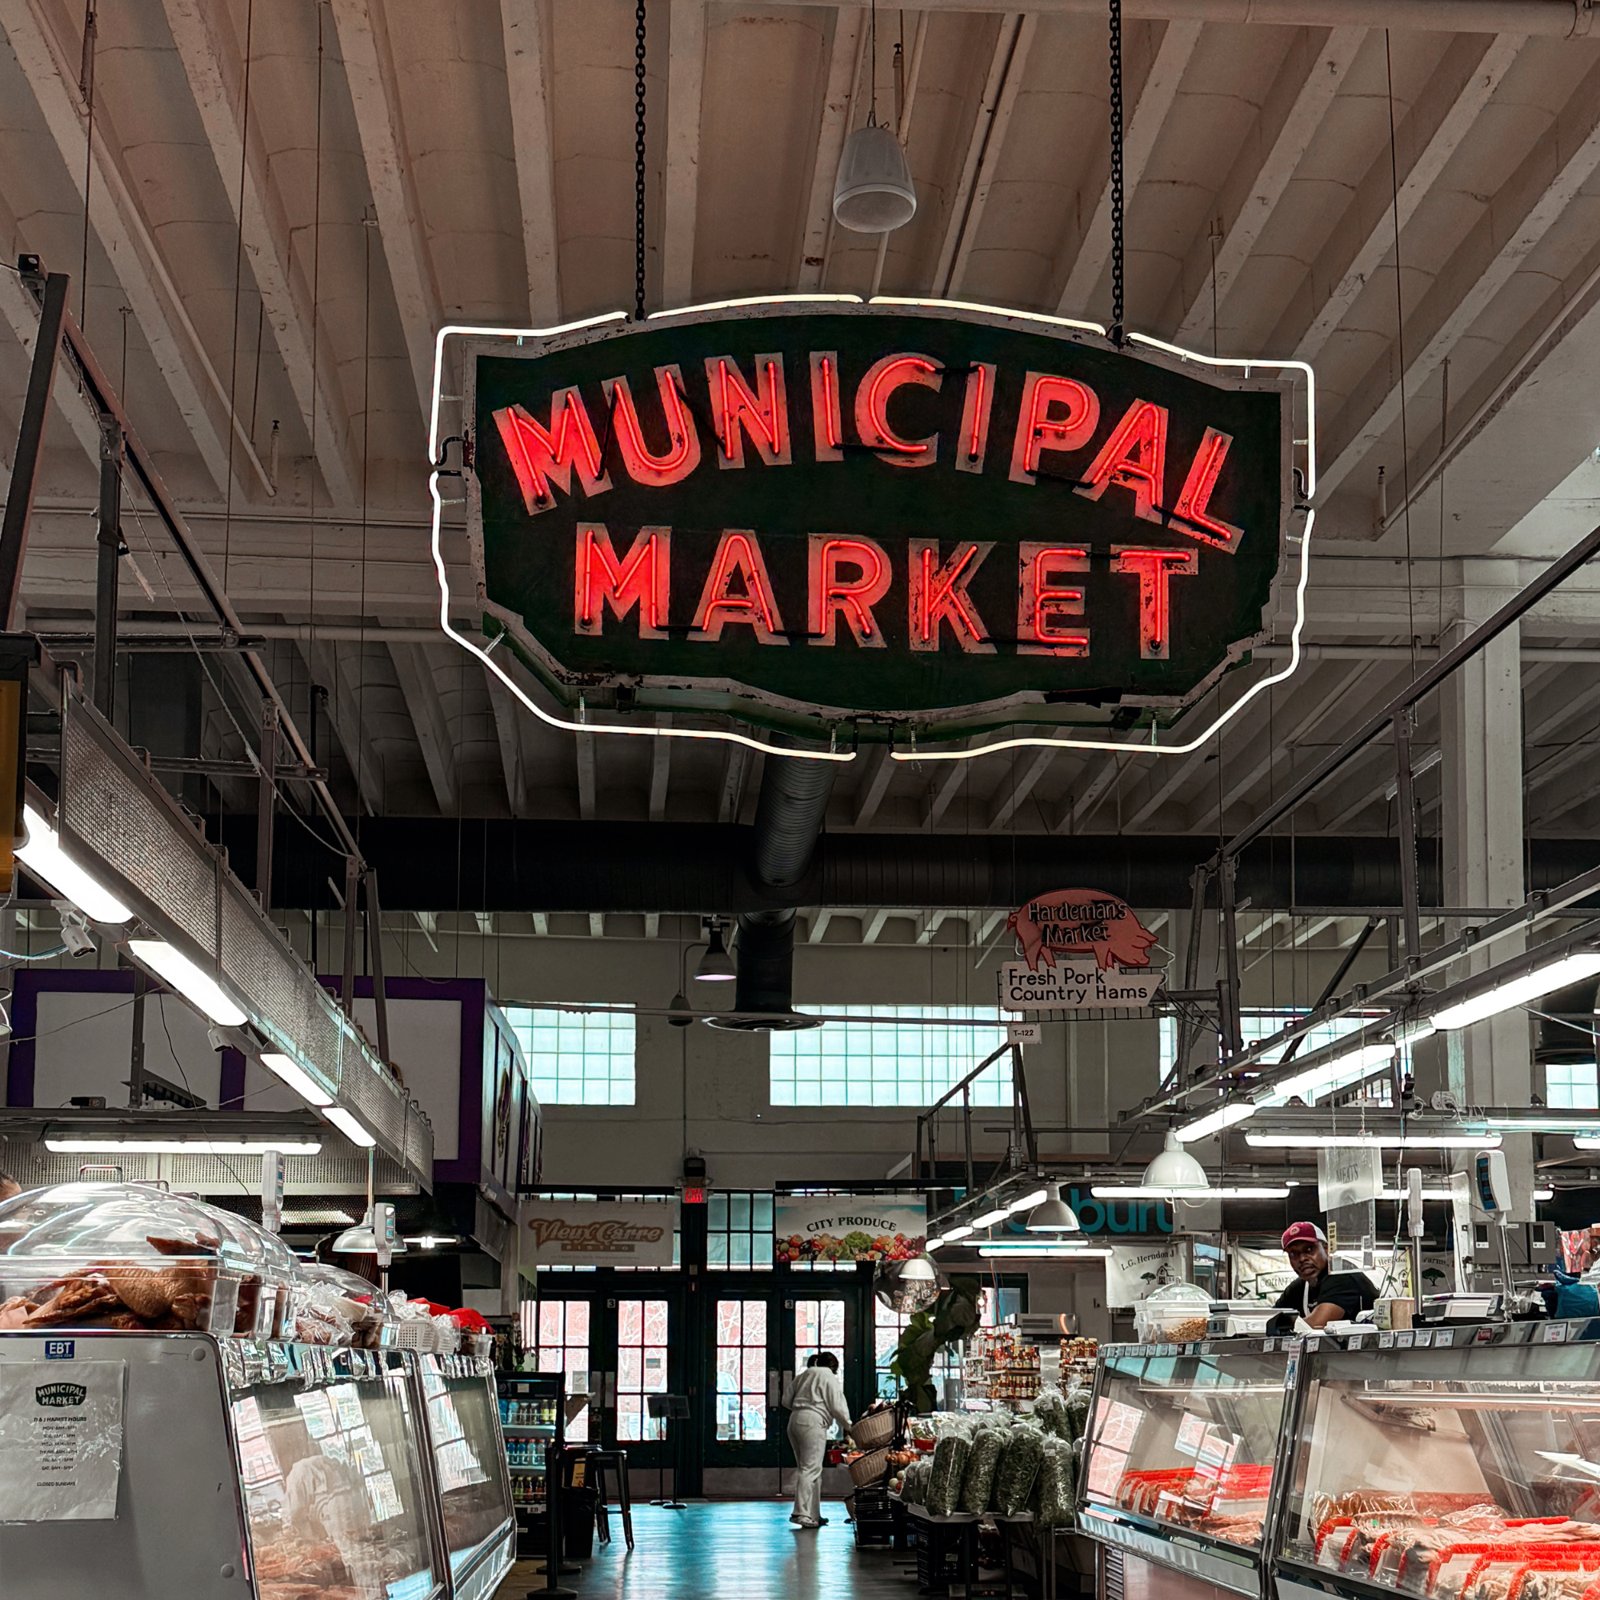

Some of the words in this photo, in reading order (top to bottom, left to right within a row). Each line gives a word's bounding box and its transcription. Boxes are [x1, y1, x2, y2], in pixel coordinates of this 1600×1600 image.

[493, 350, 1245, 553] MUNICIPAL
[574, 521, 1200, 661] MARKET
[1009, 968, 1056, 986] Fresh
[1064, 967, 1104, 985] Pork
[1010, 986, 1087, 1004] Country
[1096, 985, 1148, 1000] Hams
[806, 1219, 833, 1233] CITY
[838, 1216, 897, 1232] PRODUCE
[49, 1342, 72, 1355] EBT
[37, 1384, 85, 1397] MUNICIPAL
[41, 1395, 81, 1405] MARKET
